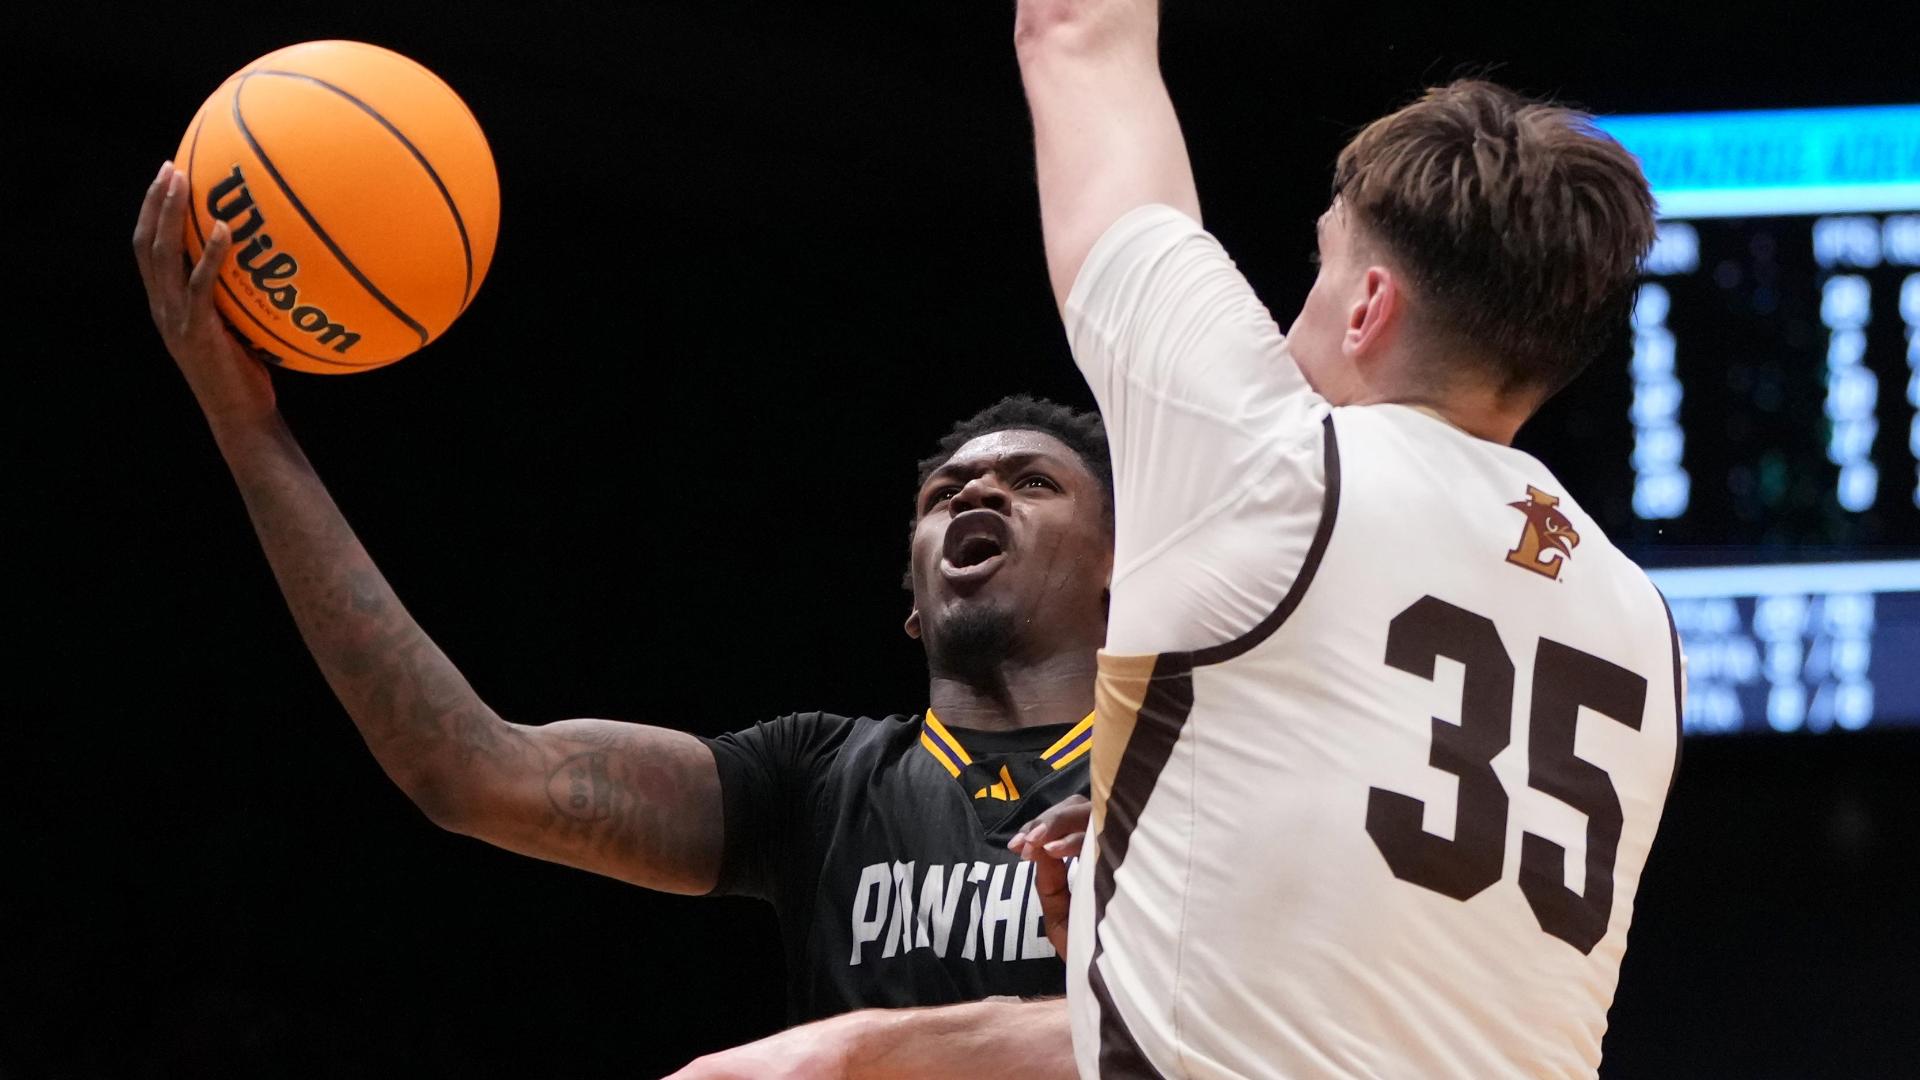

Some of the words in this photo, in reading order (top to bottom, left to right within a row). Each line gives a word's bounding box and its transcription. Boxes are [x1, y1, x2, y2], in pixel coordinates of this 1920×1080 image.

[207, 165, 361, 352] Wilson
[1366, 594, 1648, 956] 35
[850, 860, 1079, 966] PANTHE
